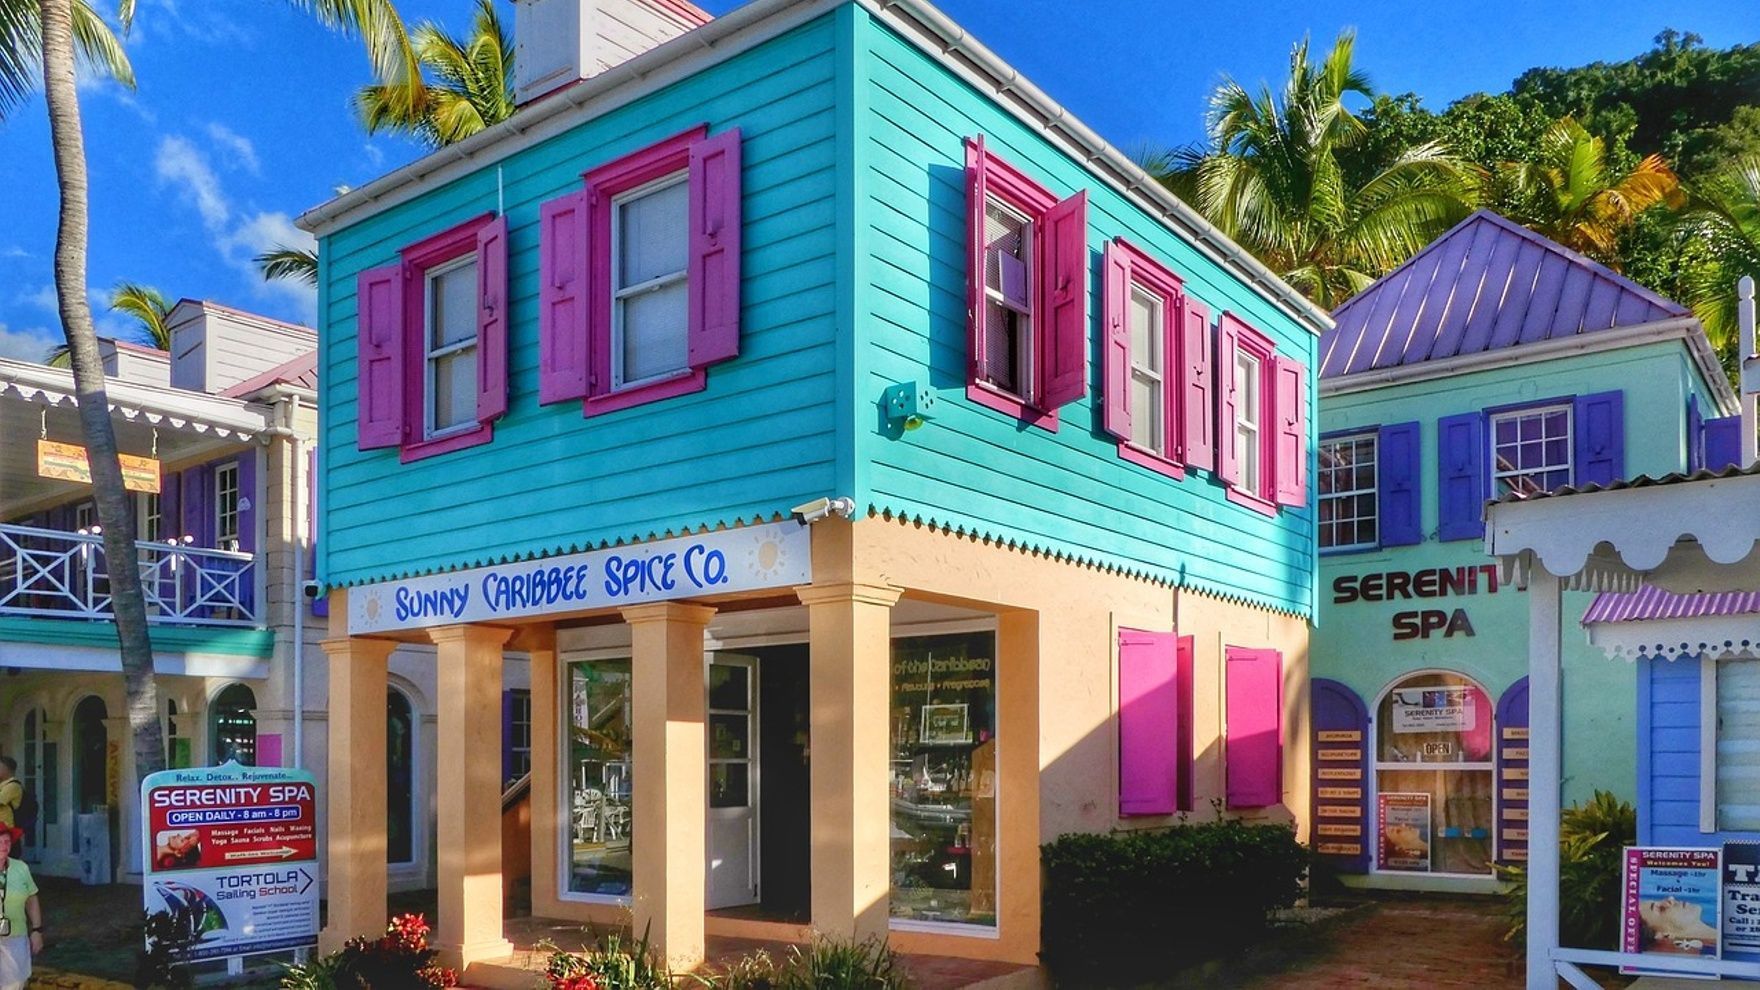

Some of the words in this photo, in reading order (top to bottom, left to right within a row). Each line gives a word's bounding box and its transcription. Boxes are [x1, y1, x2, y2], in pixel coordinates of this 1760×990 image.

[395, 583, 469, 622] SUNNY
[481, 564, 589, 612] CARIBBEE
[604, 552, 677, 597] SPICE
[1333, 563, 1527, 604] SERENIT
[1392, 608, 1476, 640] SPA
[1425, 743, 1450, 754] OPEN
[154, 786, 262, 807] SERENITY
[269, 786, 311, 803] SPA
[172, 812, 203, 823] OPEN
[206, 810, 236, 821] DAILY
[243, 810, 250, 820] 8
[252, 810, 267, 819] am
[274, 808, 281, 818] 8
[282, 809, 298, 820] pm
[1642, 851, 1691, 859] SERENITY
[216, 870, 299, 889] TORTOLA
[1650, 869, 1689, 878] Massage
[1728, 864, 1760, 882] T
[216, 888, 256, 900] Sailing
[259, 884, 298, 897] School
[1656, 885, 1682, 893] Facial
[1627, 917, 1636, 953] OFFE
